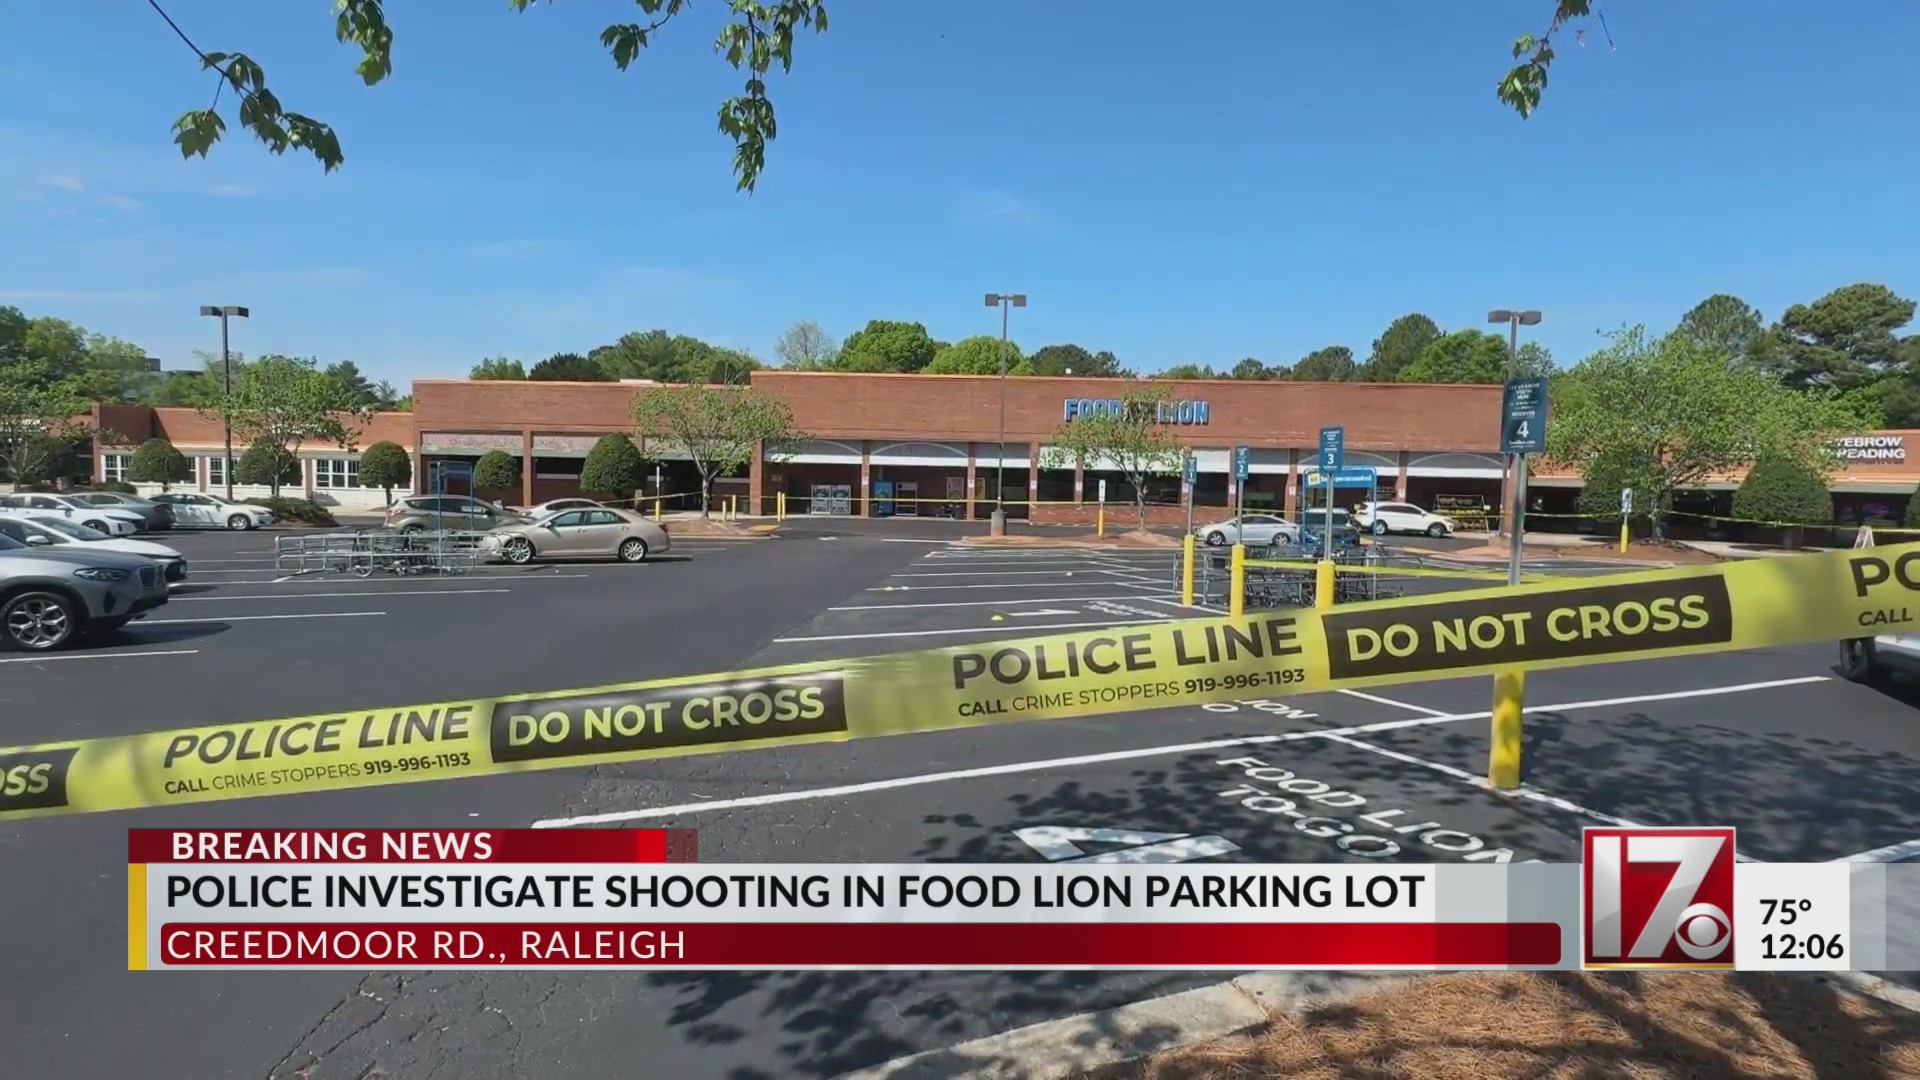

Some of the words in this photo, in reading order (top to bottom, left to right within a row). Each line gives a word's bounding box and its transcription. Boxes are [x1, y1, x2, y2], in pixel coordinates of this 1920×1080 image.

[1158, 400, 1210, 425] LION
[1516, 420, 1530, 438] 4
[1327, 453, 1335, 465] 3
[1826, 436, 1903, 447] YEBROW
[1239, 465, 1245, 473] 2
[1346, 624, 1419, 662] DO
[1433, 611, 1532, 653] NOT
[1546, 595, 1710, 642] CROSS
[1858, 607, 1914, 626] CALL
[953, 633, 1156, 690] POLICE
[1172, 617, 1303, 666] LINE
[958, 699, 1008, 717] CALL
[1012, 692, 1074, 712] CRIME
[1079, 681, 1180, 705] STOPPERS
[1185, 668, 1305, 694] 919-996-1193
[164, 718, 347, 768] POLICE
[358, 705, 474, 749] LINE
[509, 711, 570, 746] DO
[584, 701, 671, 740] NOT
[682, 687, 825, 730] CROSS
[165, 778, 209, 795] CALL
[212, 771, 267, 790] CRIME
[271, 763, 361, 785] STOPPERS
[364, 752, 471, 775] 919-996-1193
[1216, 757, 1367, 807] FOOD
[1216, 784, 1401, 857] TO-GO
